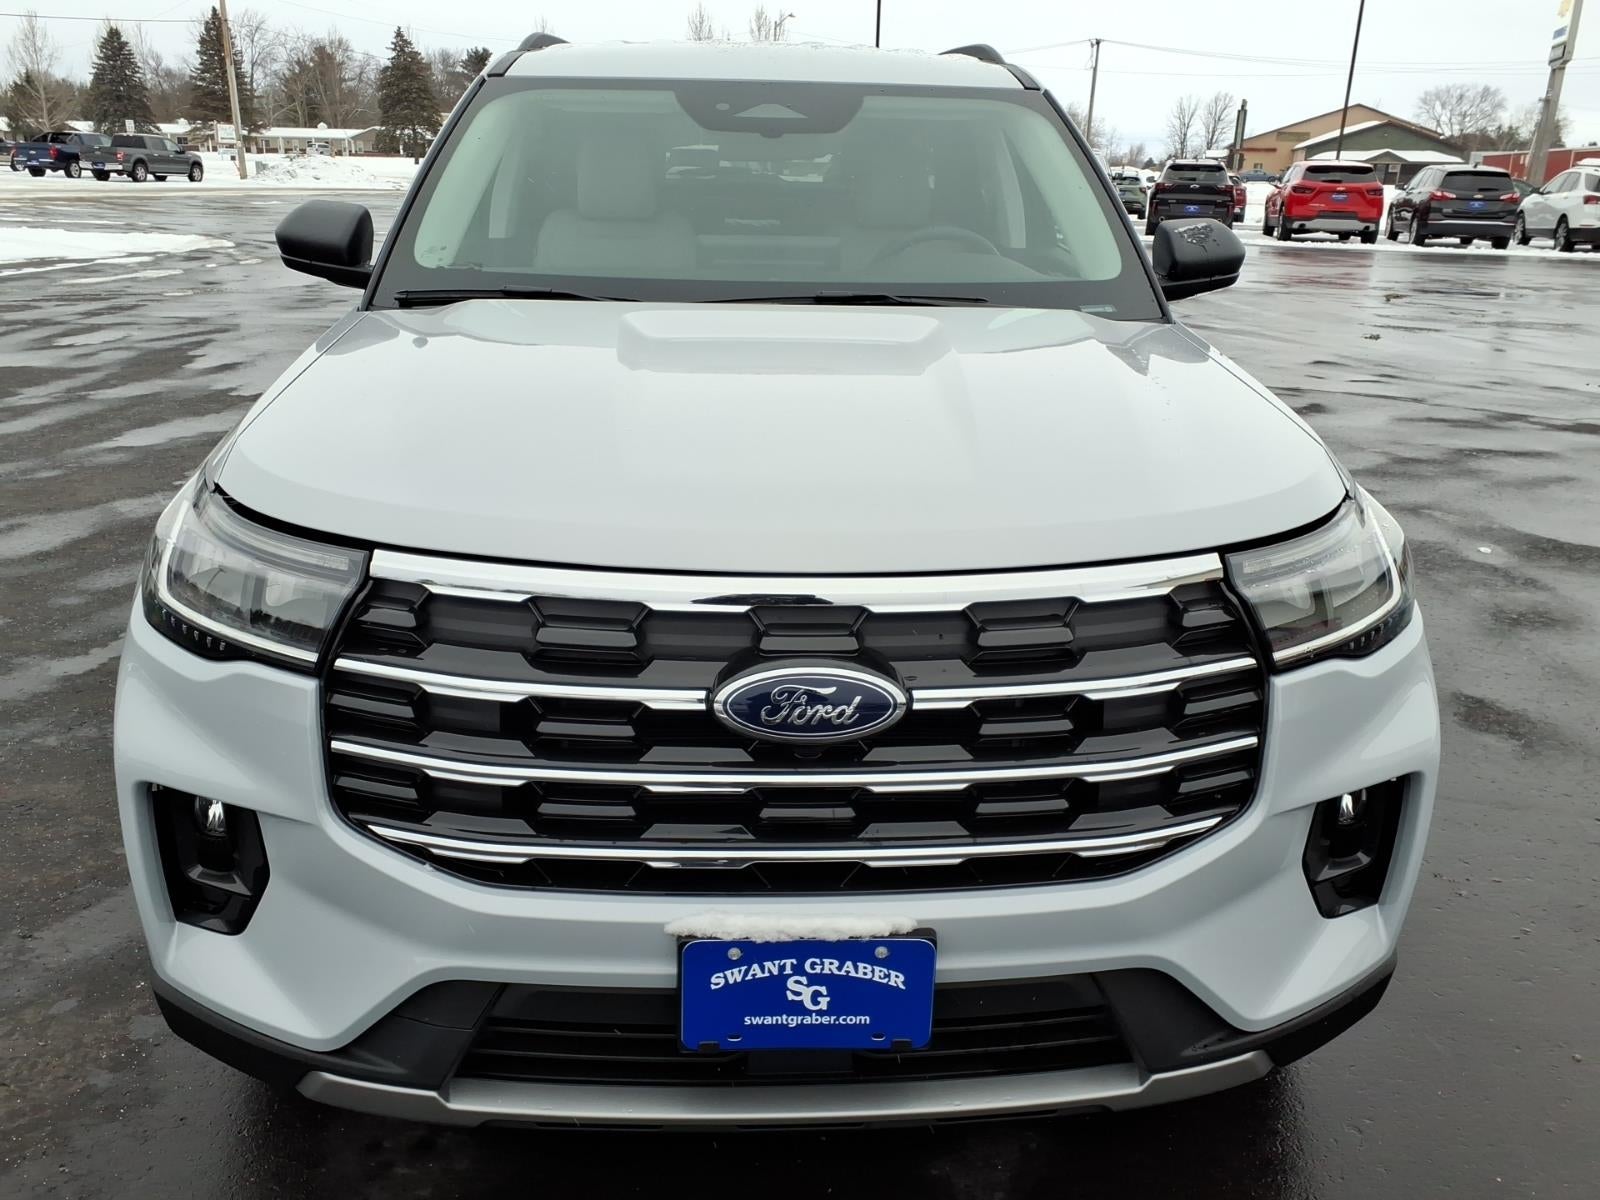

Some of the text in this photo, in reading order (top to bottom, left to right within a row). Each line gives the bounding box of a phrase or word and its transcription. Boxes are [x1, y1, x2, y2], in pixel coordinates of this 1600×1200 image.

[760, 684, 863, 726] Ford
[710, 958, 906, 990] SWANT GRABER
[786, 975, 830, 1010] SG
[743, 1013, 870, 1027] swantgraber.com
